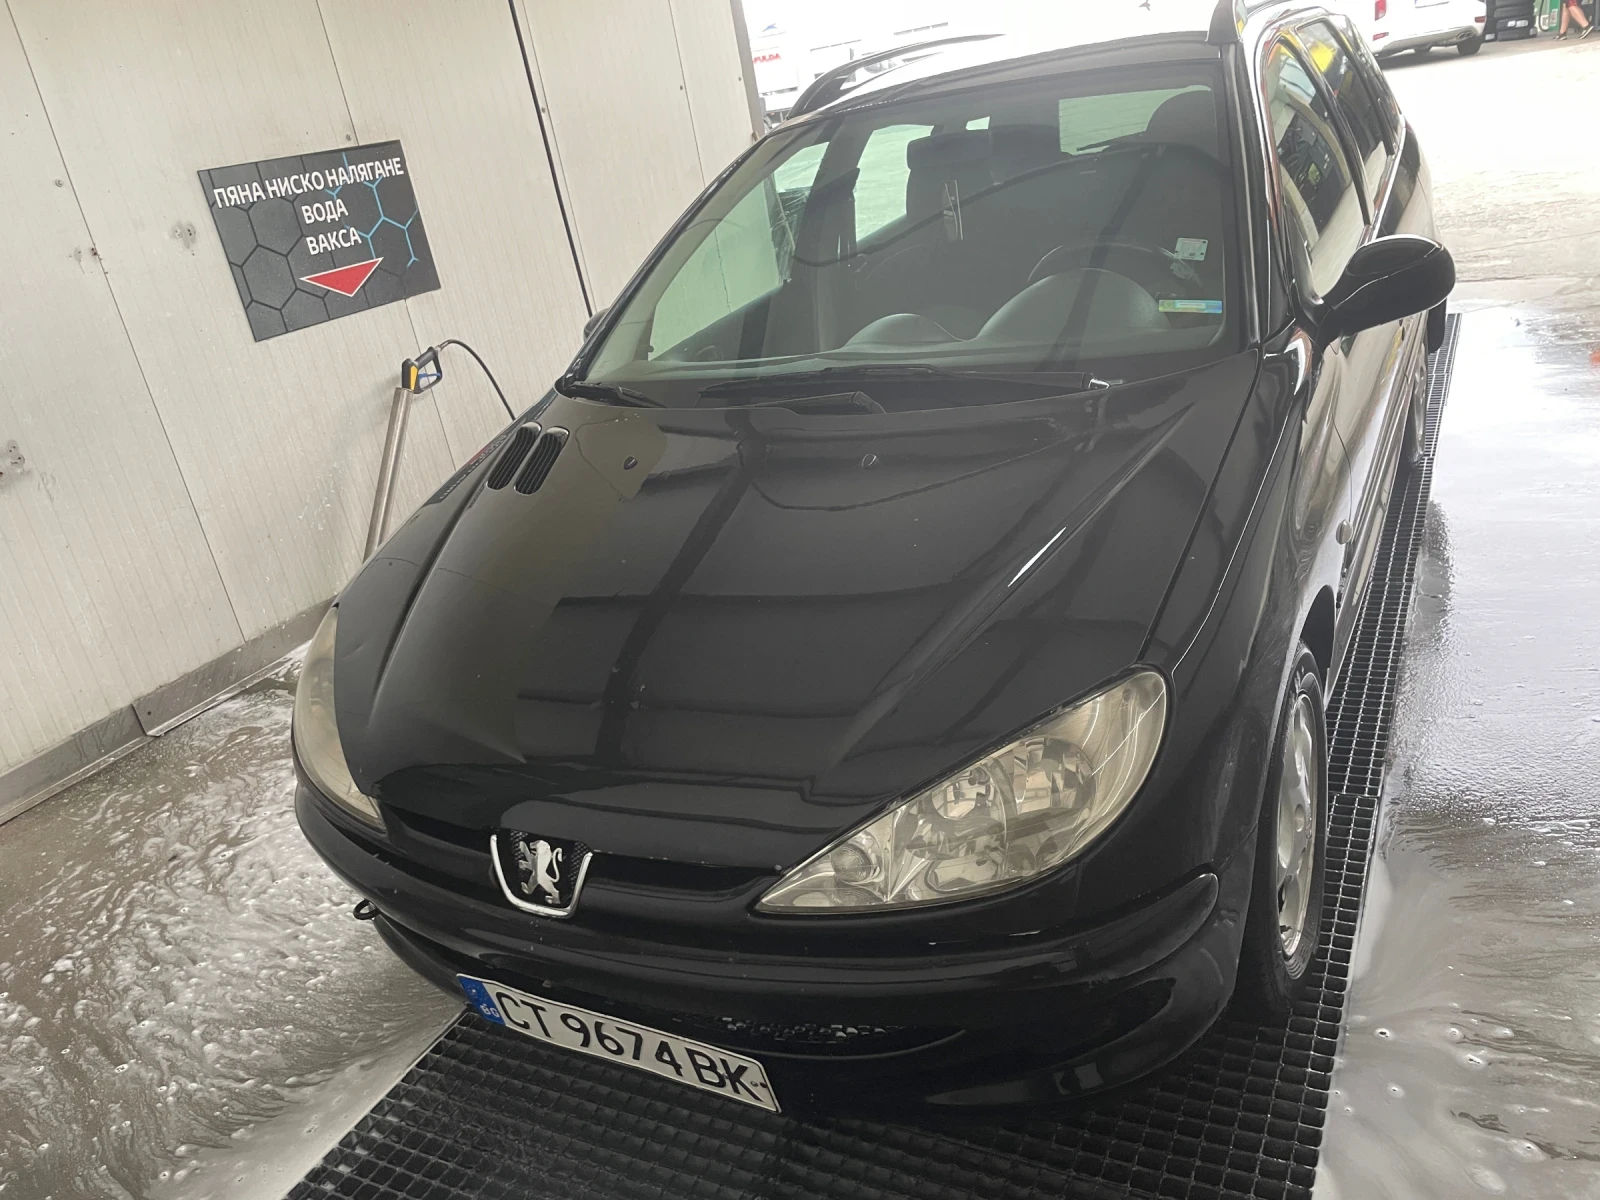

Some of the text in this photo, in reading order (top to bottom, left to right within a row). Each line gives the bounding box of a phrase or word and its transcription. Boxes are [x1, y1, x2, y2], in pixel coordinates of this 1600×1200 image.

[213, 157, 404, 209] ПЯНА НИСКО НАЛЯГАНЕ
[301, 198, 349, 224] ВОДА
[306, 226, 362, 255] ВАКСА
[560, 1013, 683, 1076] 9674
